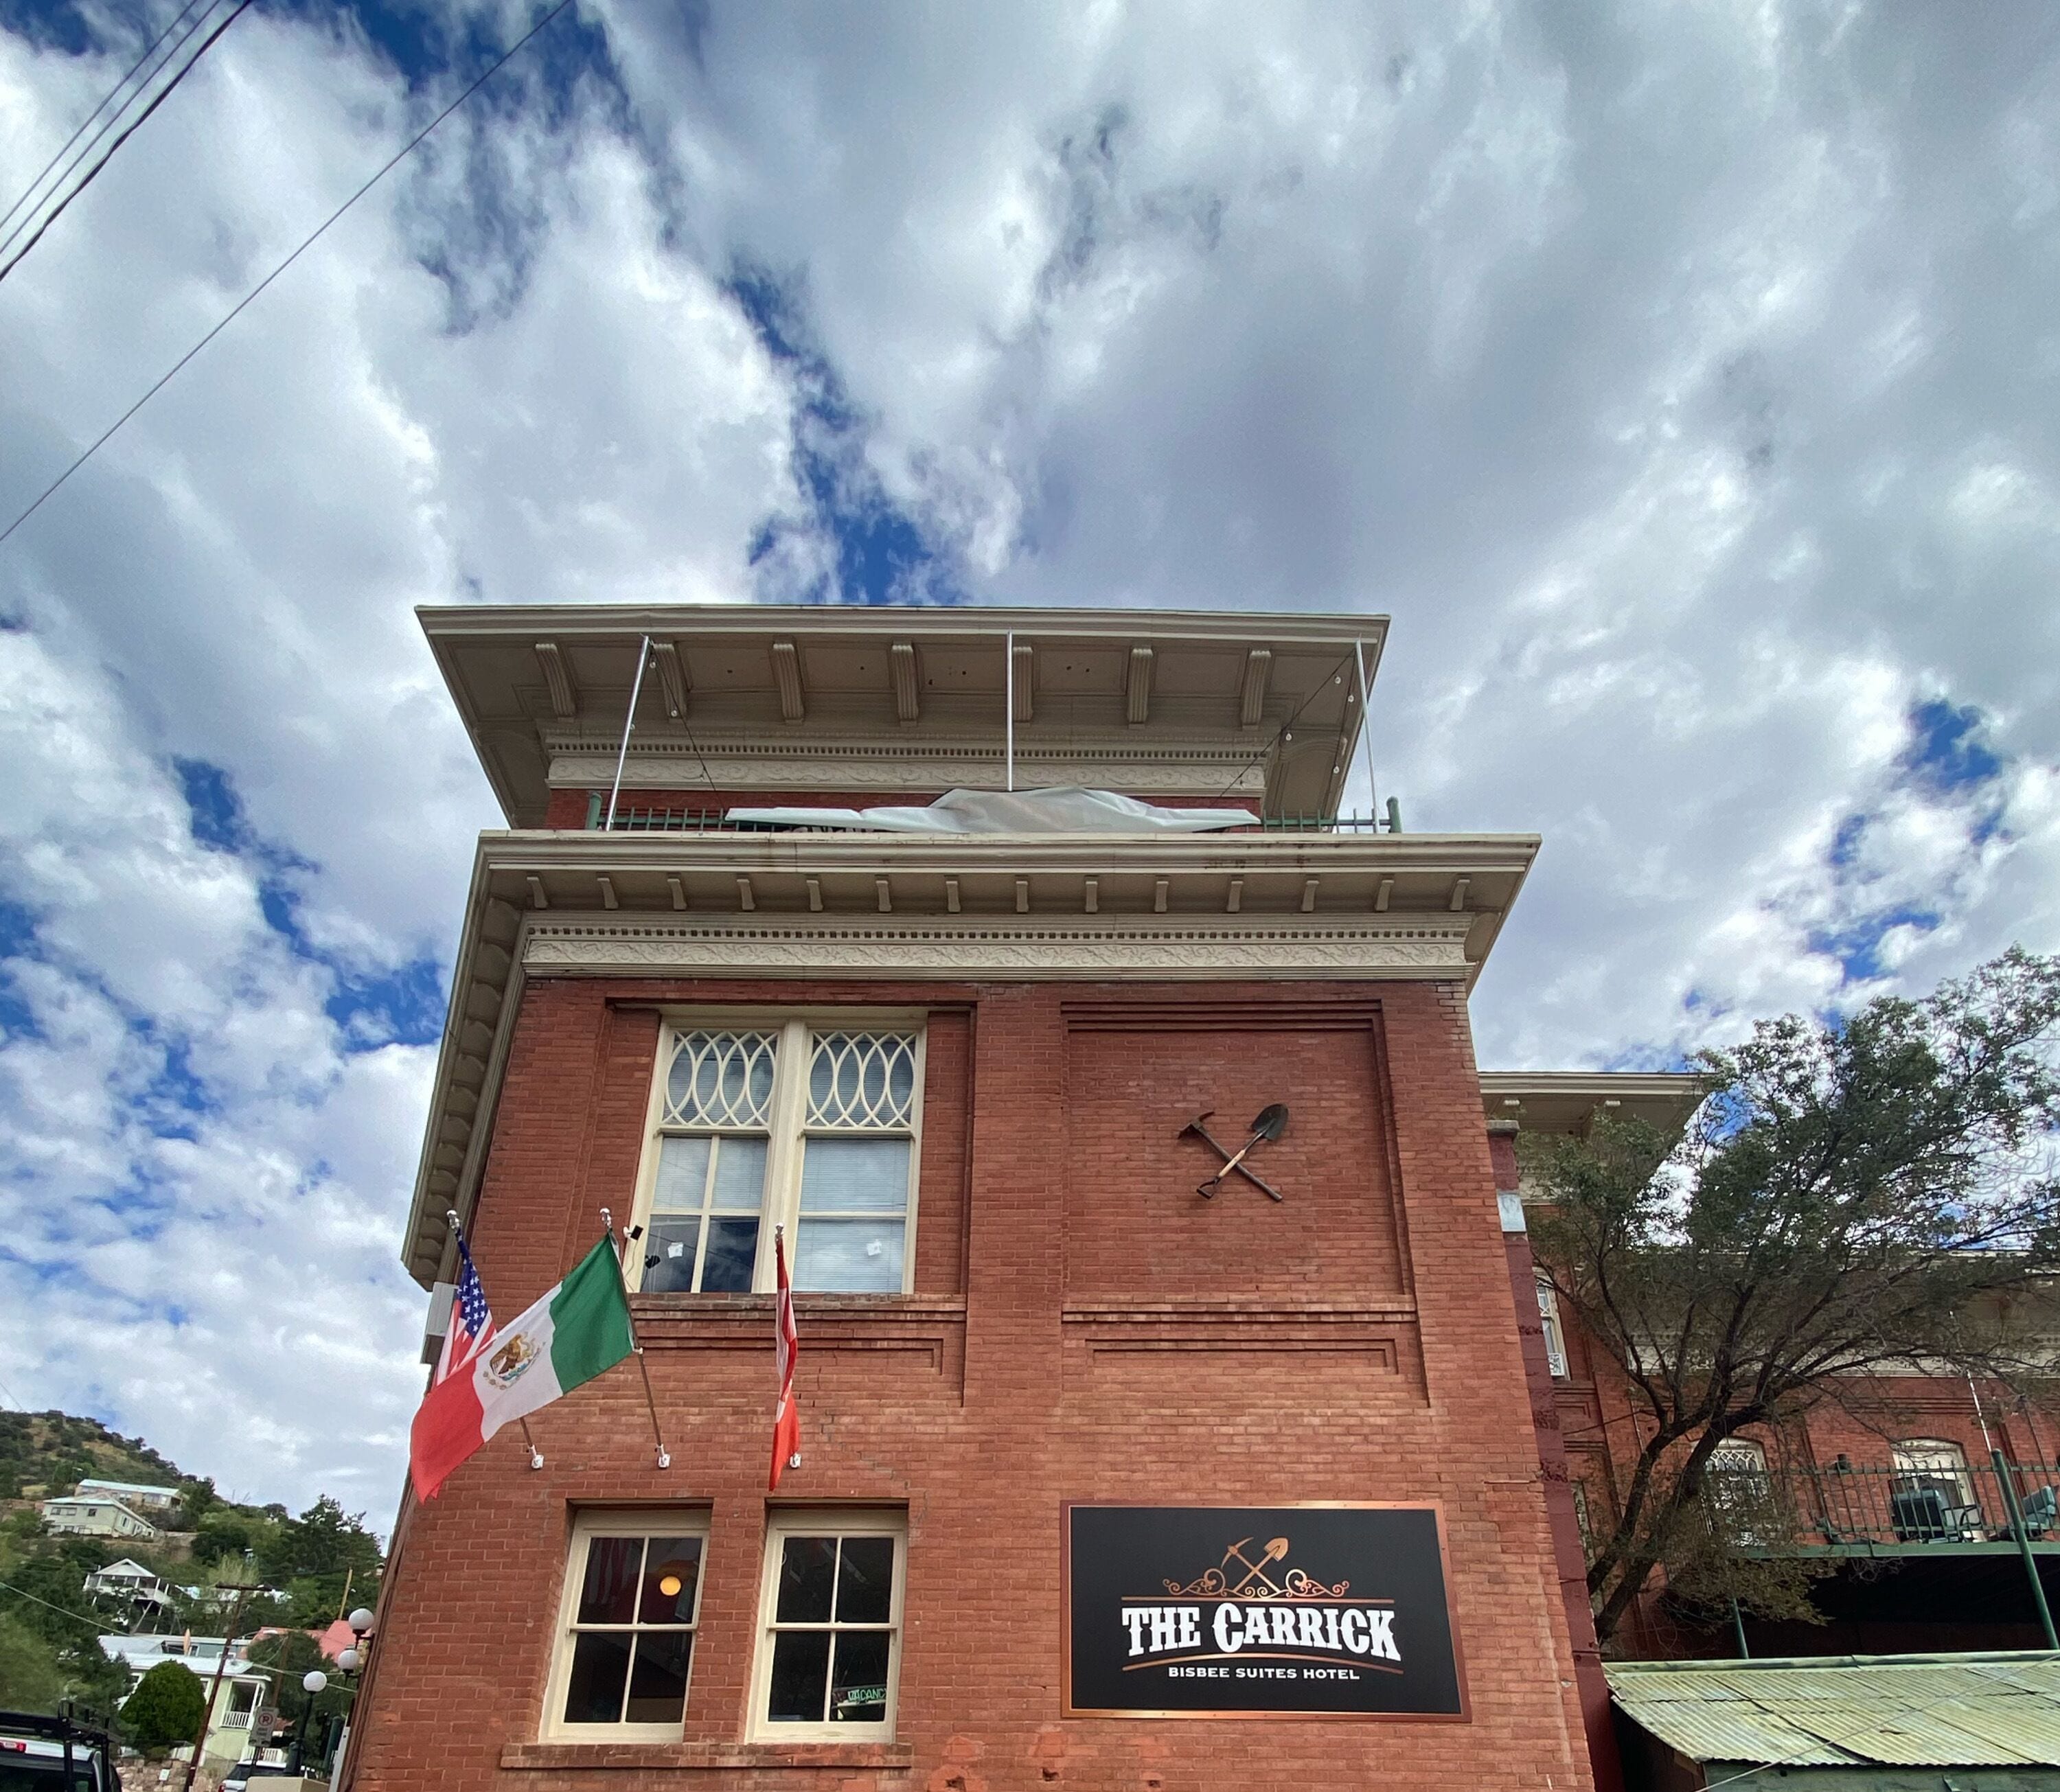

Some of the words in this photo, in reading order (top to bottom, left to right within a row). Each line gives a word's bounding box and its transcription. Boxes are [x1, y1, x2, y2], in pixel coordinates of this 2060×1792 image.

[1122, 1607, 1201, 1657] THE
[1211, 1602, 1401, 1662] CARRICK
[1169, 1667, 1230, 1677] BISBEE
[1236, 1668, 1297, 1679] SUITES
[1303, 1669, 1360, 1679] HOTEL
[847, 1688, 886, 1701] VACANC
